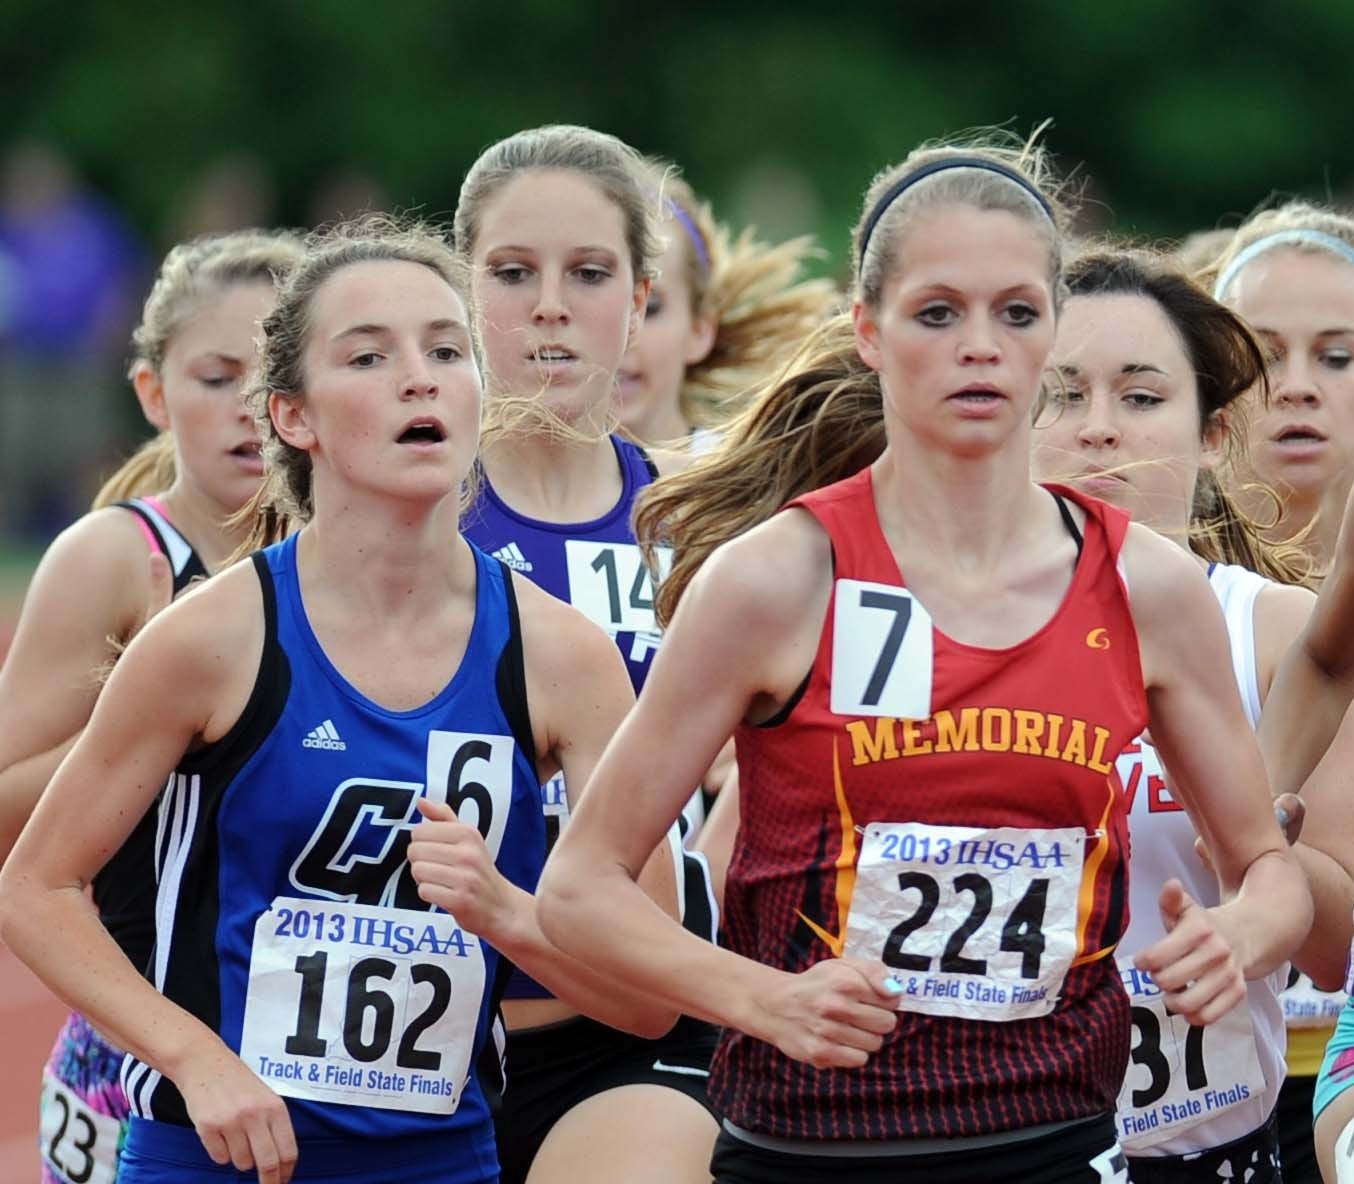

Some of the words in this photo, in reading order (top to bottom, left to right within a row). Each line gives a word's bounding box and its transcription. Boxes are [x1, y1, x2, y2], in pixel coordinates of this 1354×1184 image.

[591, 549, 656, 624] 14
[859, 590, 912, 706] 7
[302, 738, 347, 751] adidas
[846, 707, 1114, 775] MEMORIAL
[445, 740, 493, 840] 6
[880, 834, 951, 865] 2013
[955, 840, 1071, 870] IHSAA
[275, 908, 346, 943] 2013
[350, 916, 474, 957] IHSAA
[882, 872, 1050, 979] 224
[285, 951, 451, 1071] 162
[906, 977, 918, 996] &
[923, 979, 960, 998] Field
[965, 981, 1006, 1004] State
[259, 1057, 302, 1080] Track
[308, 1064, 320, 1082] &
[325, 1066, 363, 1087] Field
[367, 1070, 406, 1092] State
[410, 1075, 453, 1097] Finals
[1123, 1110, 1159, 1136] Field
[1162, 1098, 1201, 1123] State
[1204, 1083, 1250, 1111] Finals
[50, 1093, 97, 1184] 23
